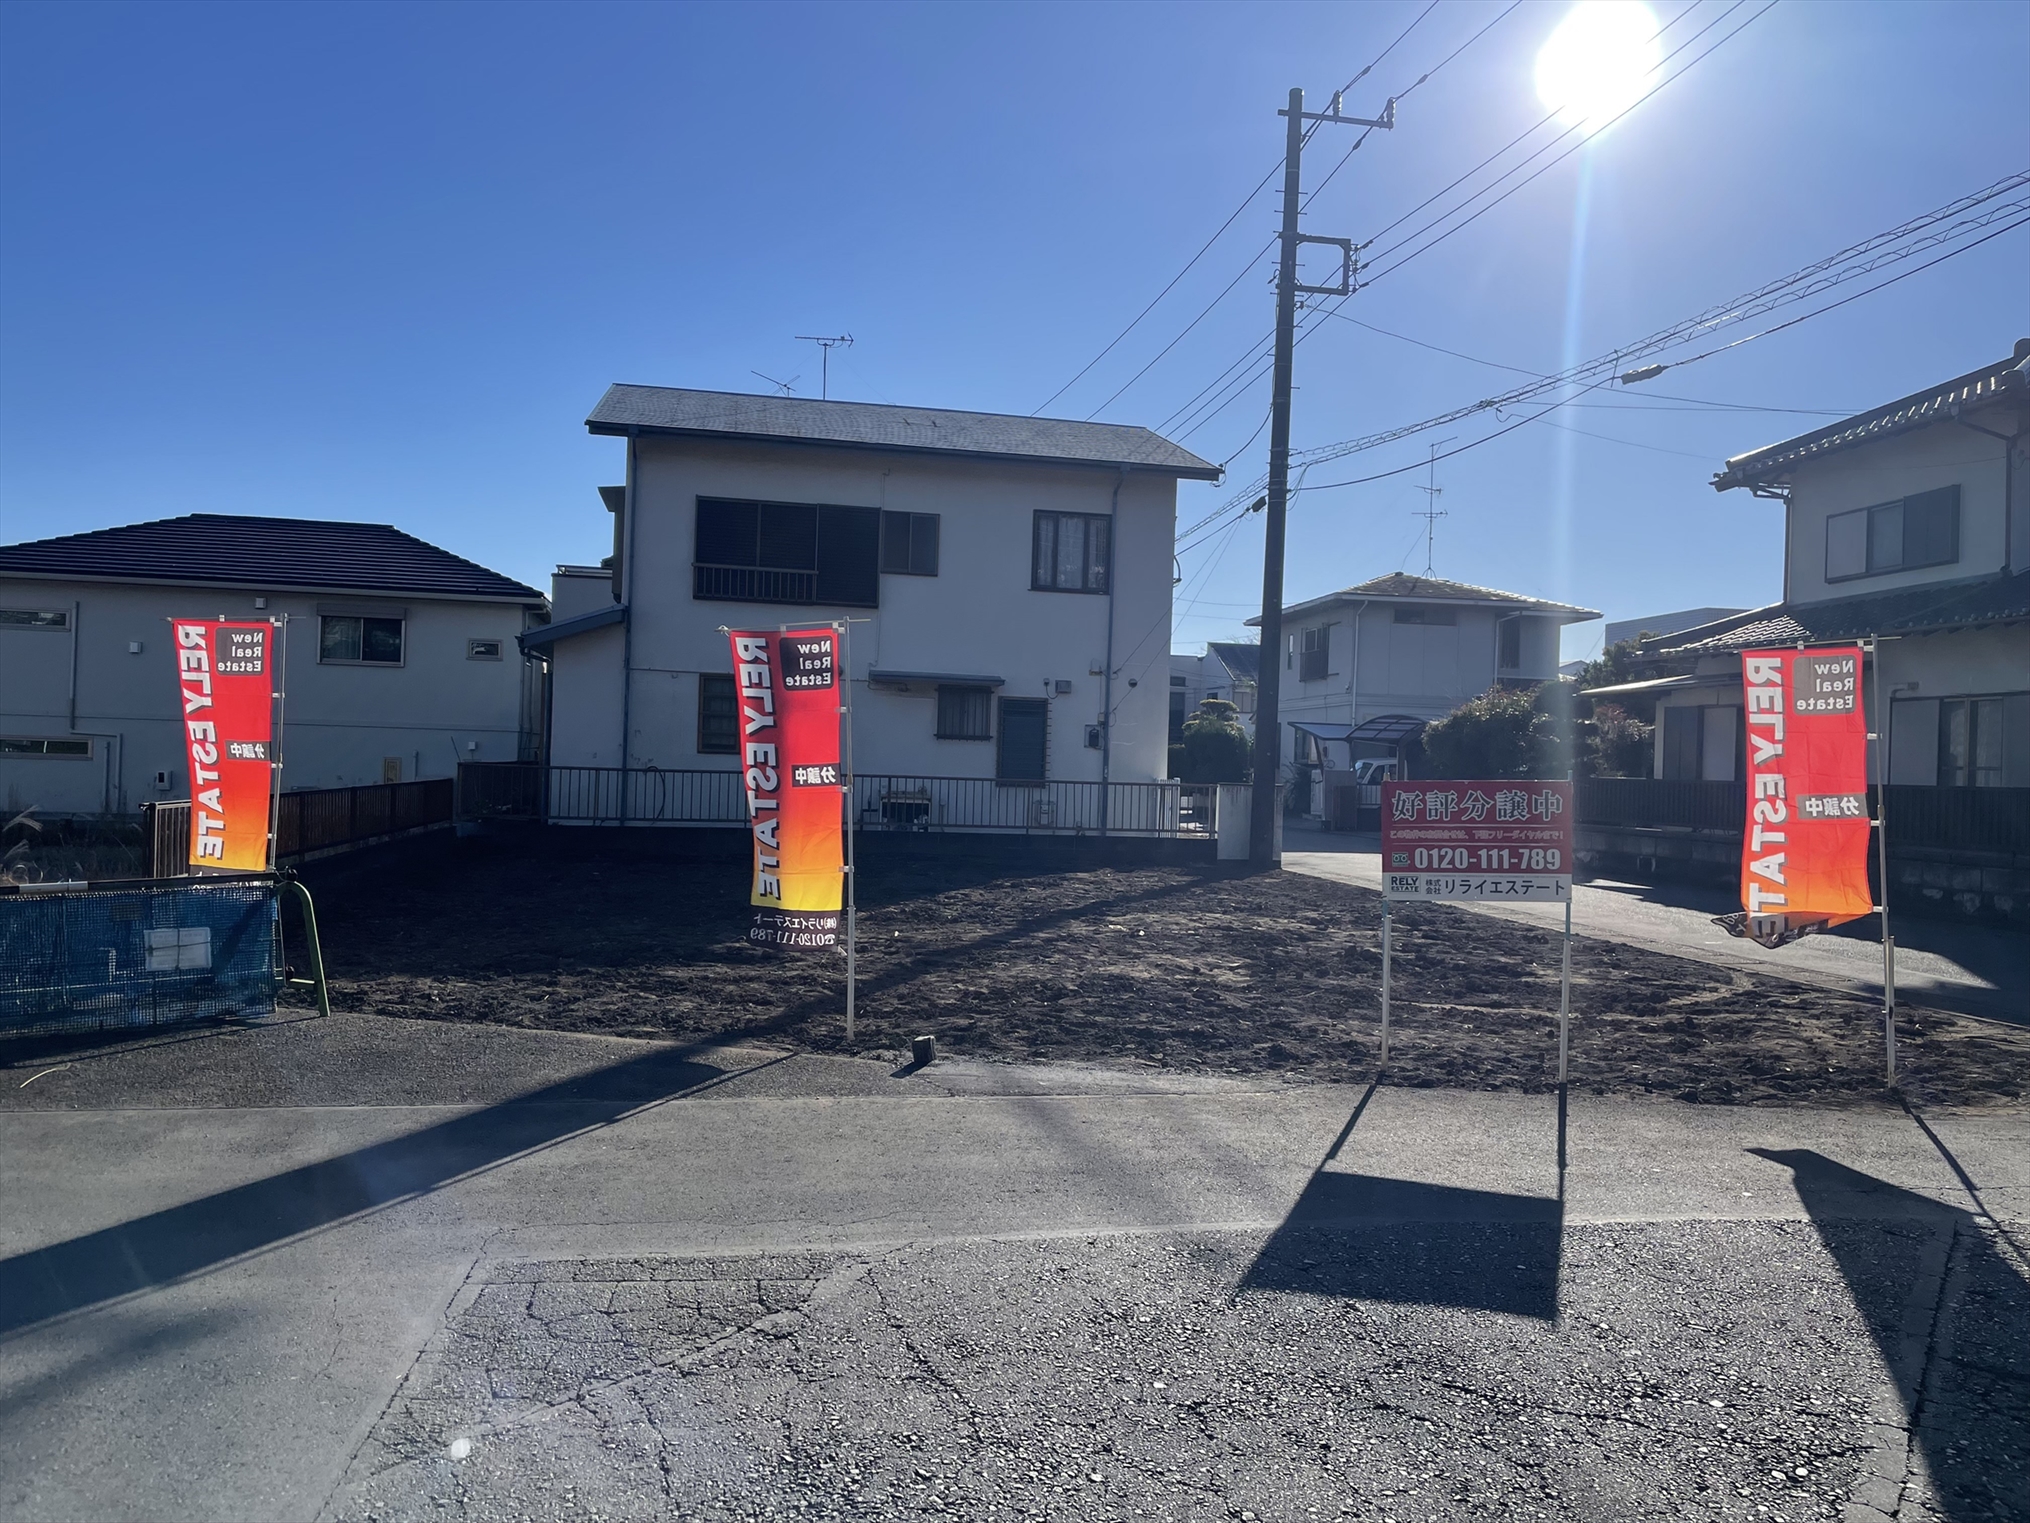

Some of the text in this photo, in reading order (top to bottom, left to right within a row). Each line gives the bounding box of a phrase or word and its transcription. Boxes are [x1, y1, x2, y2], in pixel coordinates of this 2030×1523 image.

[1392, 789, 1562, 821] 好評分譲中
[1414, 847, 1561, 870] 0120-111-789
[1391, 876, 1418, 886] RELY
[1425, 879, 1441, 887] 株式
[1425, 887, 1441, 895] 会社
[1445, 880, 1565, 895] リライエステート
